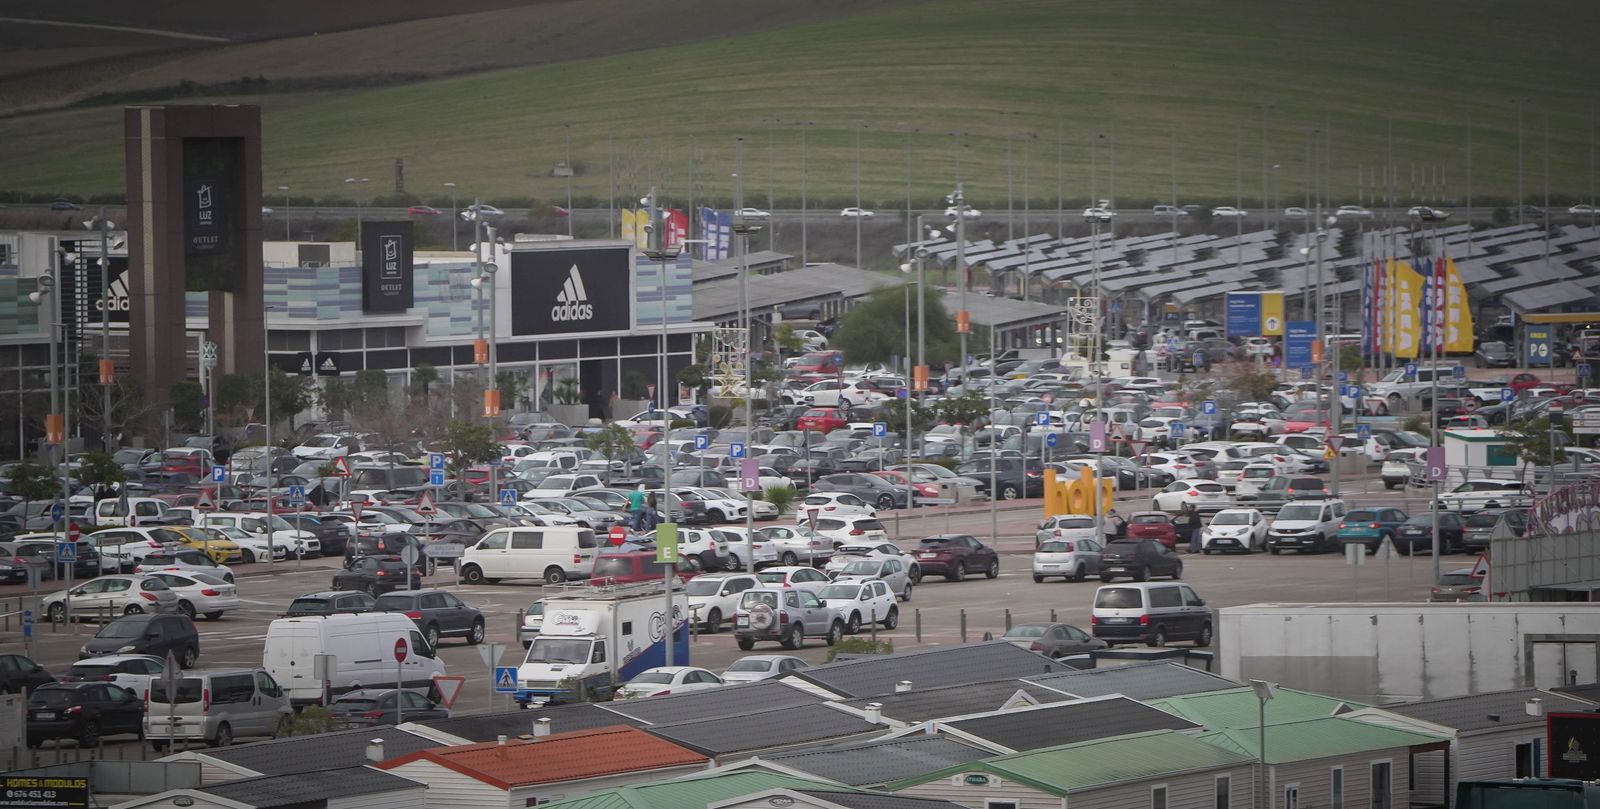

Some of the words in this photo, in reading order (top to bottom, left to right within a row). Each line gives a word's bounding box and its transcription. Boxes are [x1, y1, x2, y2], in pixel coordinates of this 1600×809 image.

[199, 211, 212, 220] LUZ
[193, 236, 218, 244] OUTLET
[386, 262, 397, 271] LUZ
[552, 301, 593, 321] adidas
[1400, 280, 1412, 350] IKEA
[1530, 343, 1538, 357] P
[1407, 364, 1415, 374] P
[1350, 387, 1358, 397] P
[1503, 389, 1511, 399] P
[1204, 403, 1213, 413] P
[1039, 413, 1047, 424] P
[875, 424, 883, 436] P
[697, 437, 705, 448] P
[1093, 439, 1102, 449] D
[733, 444, 742, 456] P
[432, 455, 442, 468] P
[214, 468, 222, 480] P
[1432, 467, 1441, 477] D
[746, 478, 755, 488] D
[663, 547, 672, 559] E
[7, 778, 38, 787] HOMES
